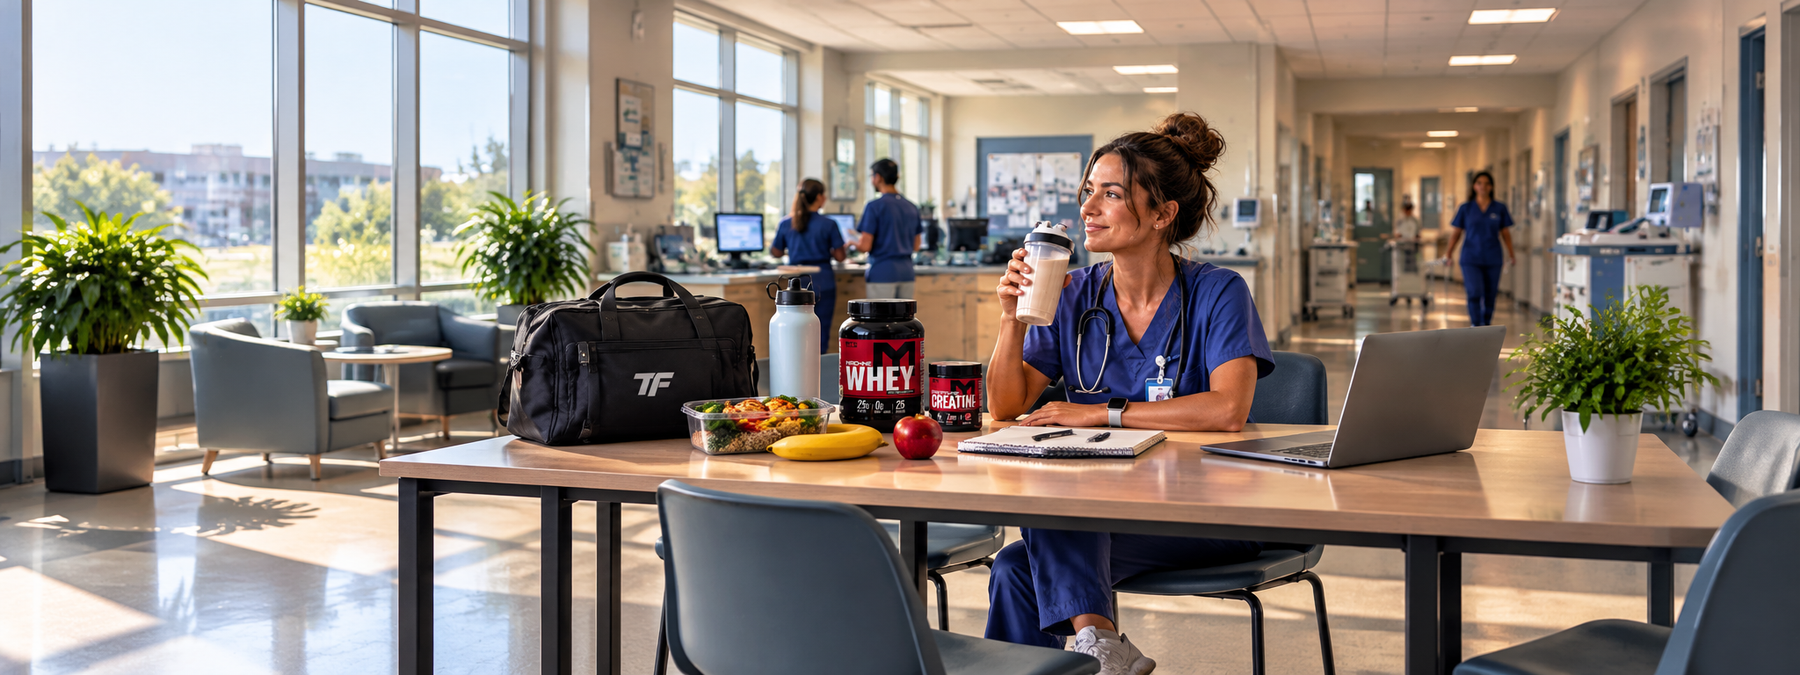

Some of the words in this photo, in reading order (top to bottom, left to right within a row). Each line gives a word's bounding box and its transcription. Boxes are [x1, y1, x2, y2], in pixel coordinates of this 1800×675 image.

[634, 372, 674, 397] TF
[846, 365, 914, 391] WHEY
[931, 394, 976, 409] CREATINE
